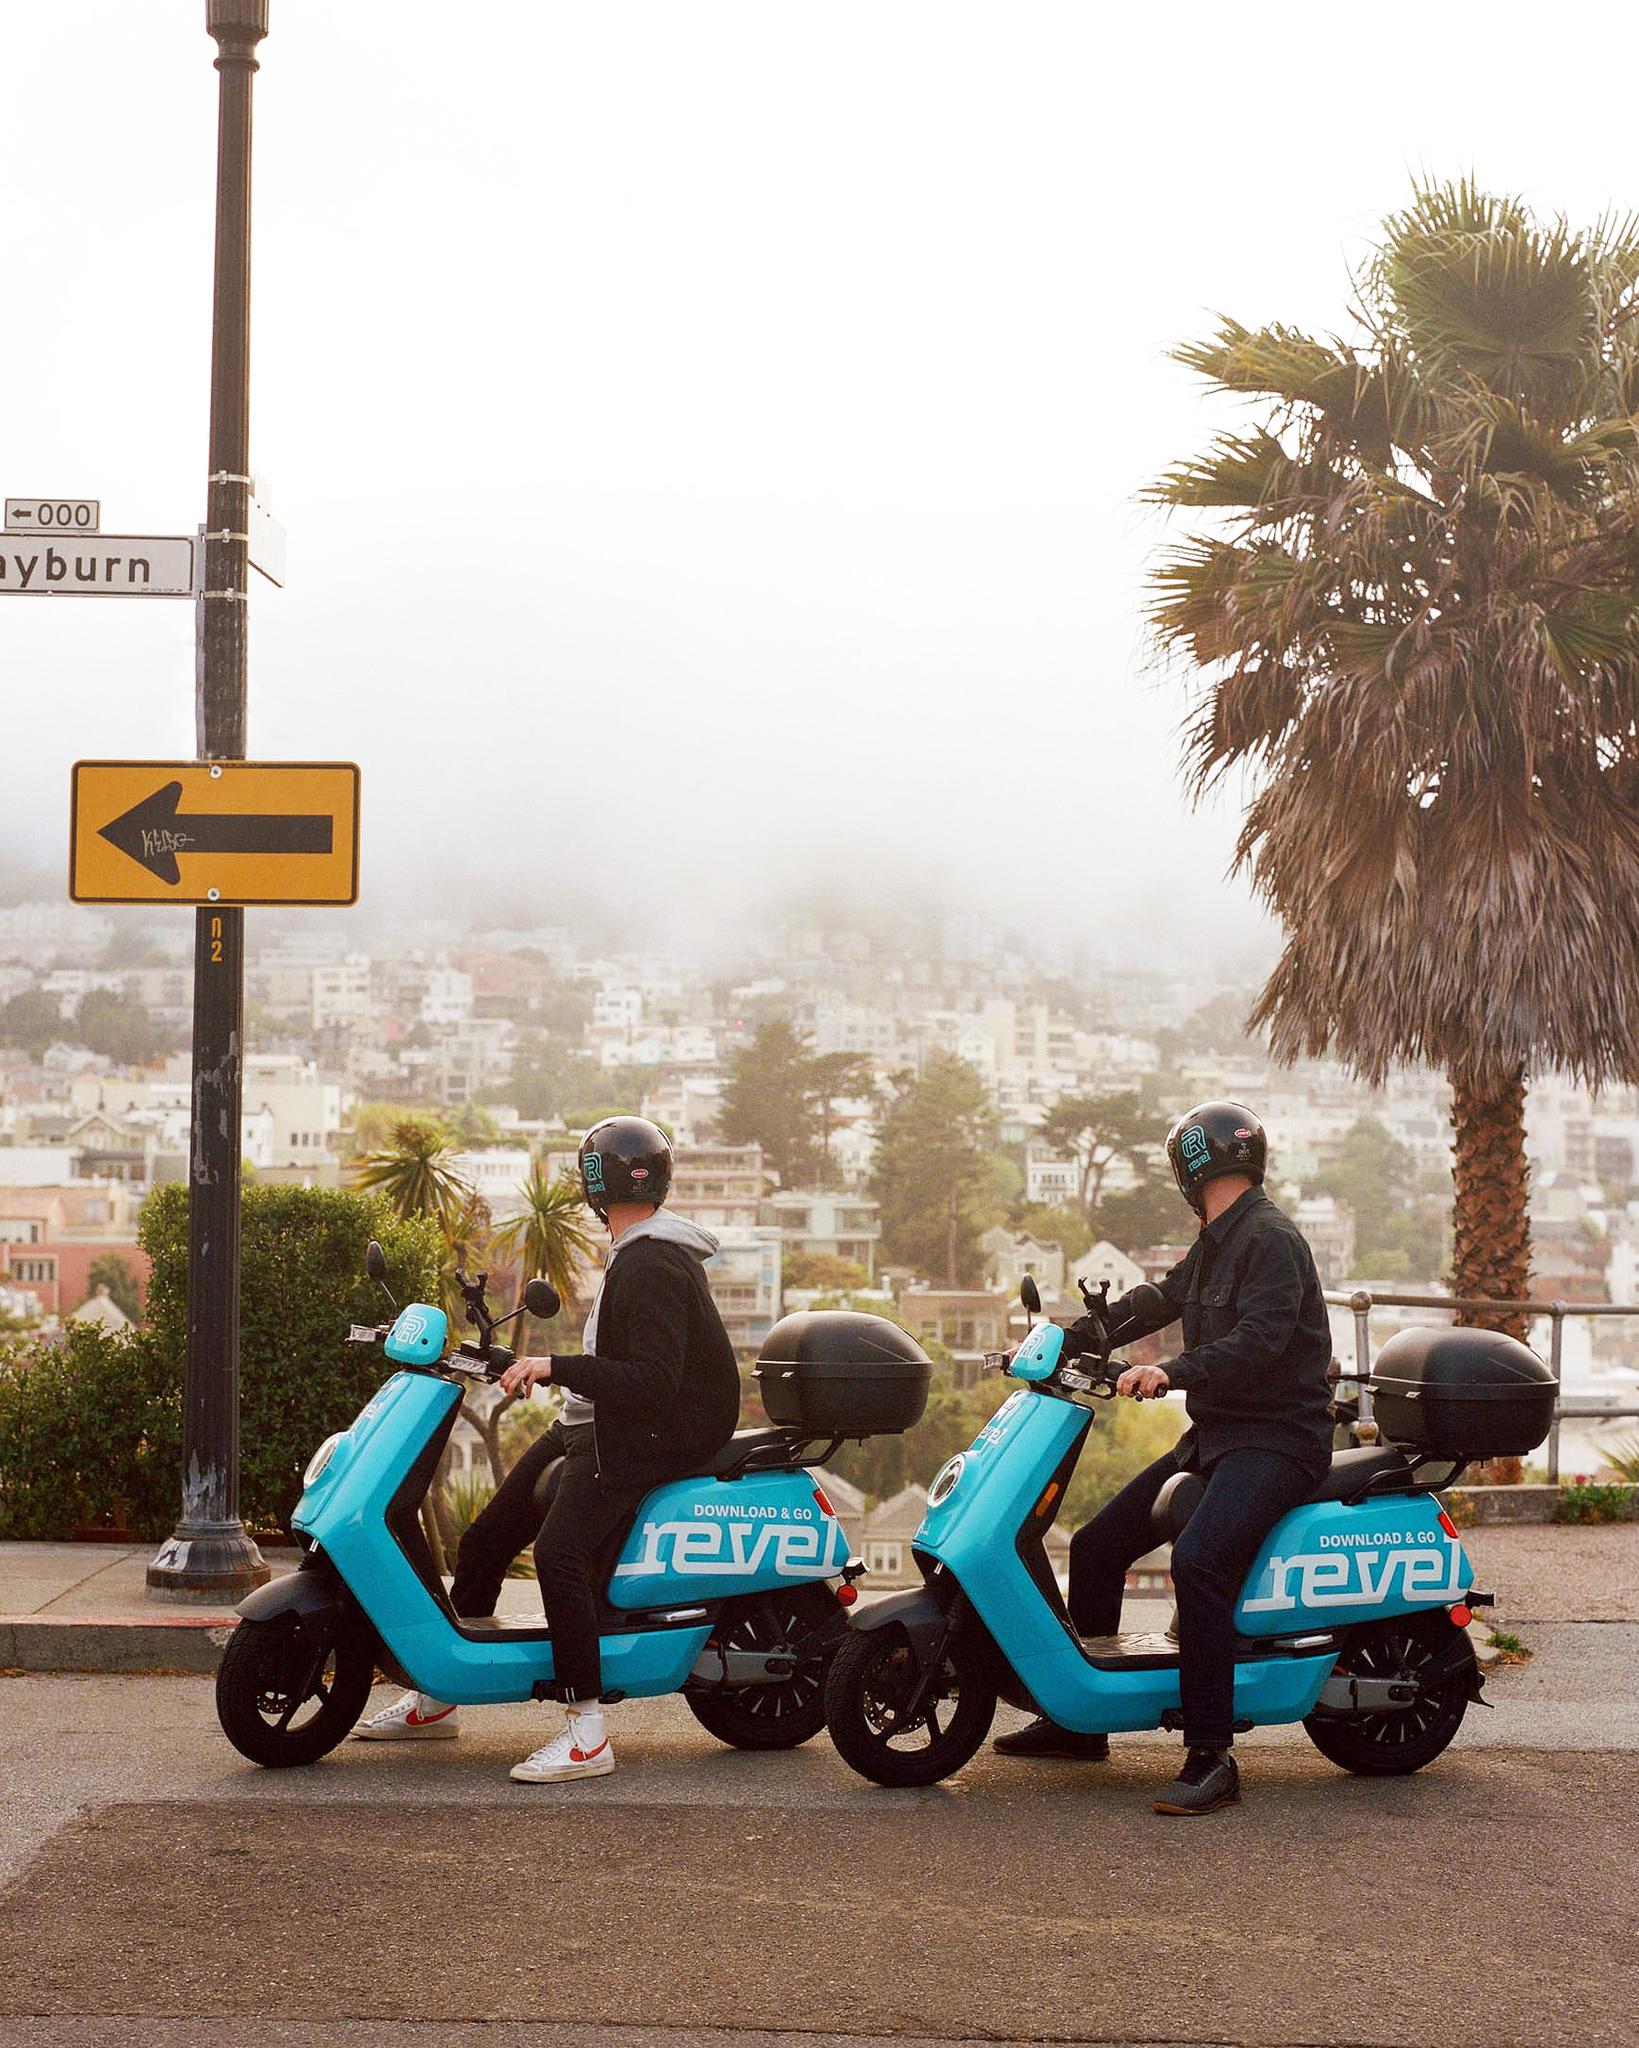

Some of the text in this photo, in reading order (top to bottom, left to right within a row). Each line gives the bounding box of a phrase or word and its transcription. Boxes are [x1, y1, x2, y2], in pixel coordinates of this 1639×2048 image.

[38, 503, 91, 527] 000
[694, 1504, 812, 1521] DOWNLOAD & GO
[614, 1516, 846, 1577] revel
[1319, 1531, 1436, 1548] DOWNLOAD & GO
[1242, 1533, 1470, 1613] revel
